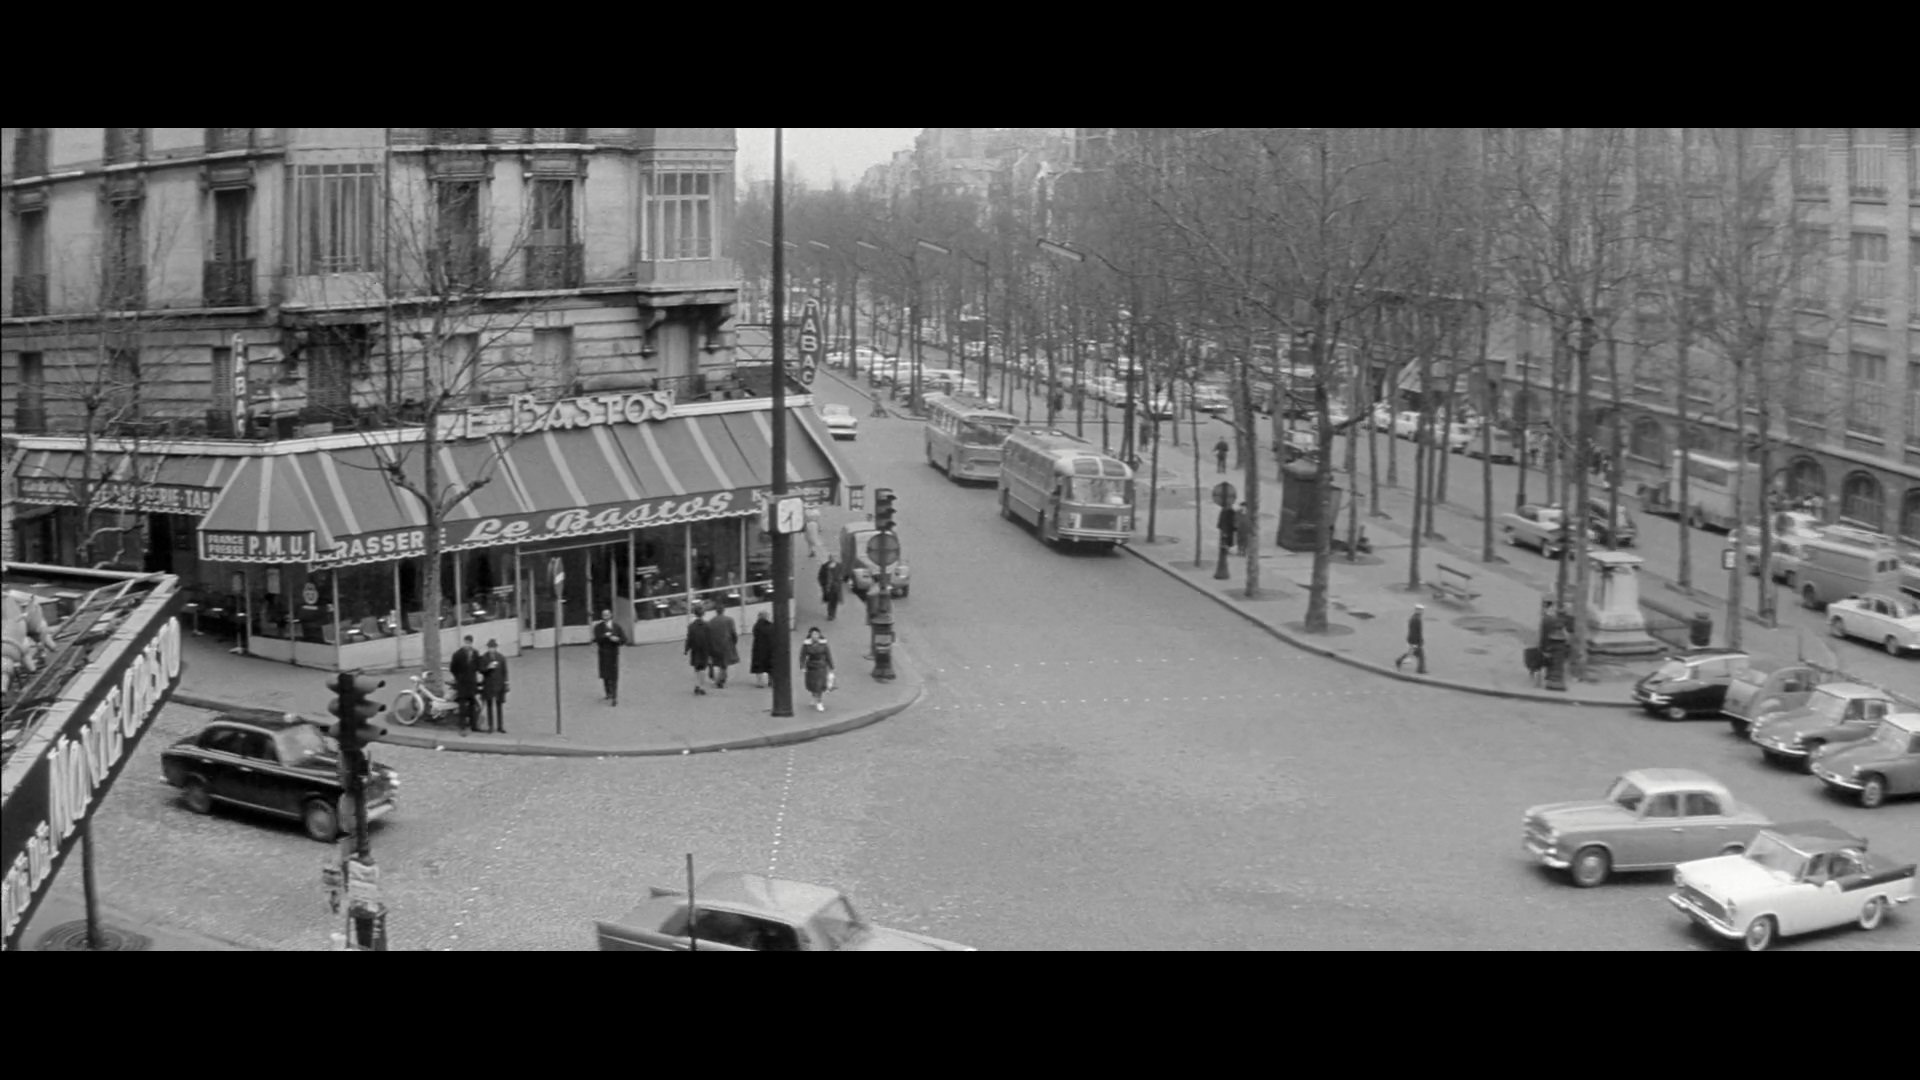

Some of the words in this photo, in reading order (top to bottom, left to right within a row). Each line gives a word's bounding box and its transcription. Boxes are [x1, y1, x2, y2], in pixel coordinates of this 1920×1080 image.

[801, 302, 818, 385] TABAC
[234, 337, 247, 433] TABAC
[509, 388, 677, 434] BASTOS
[207, 534, 245, 545] FRANCE
[462, 517, 531, 542] Le
[545, 491, 734, 533] Bastos
[207, 543, 245, 555] PRESSE
[248, 535, 307, 556] P.M.U.
